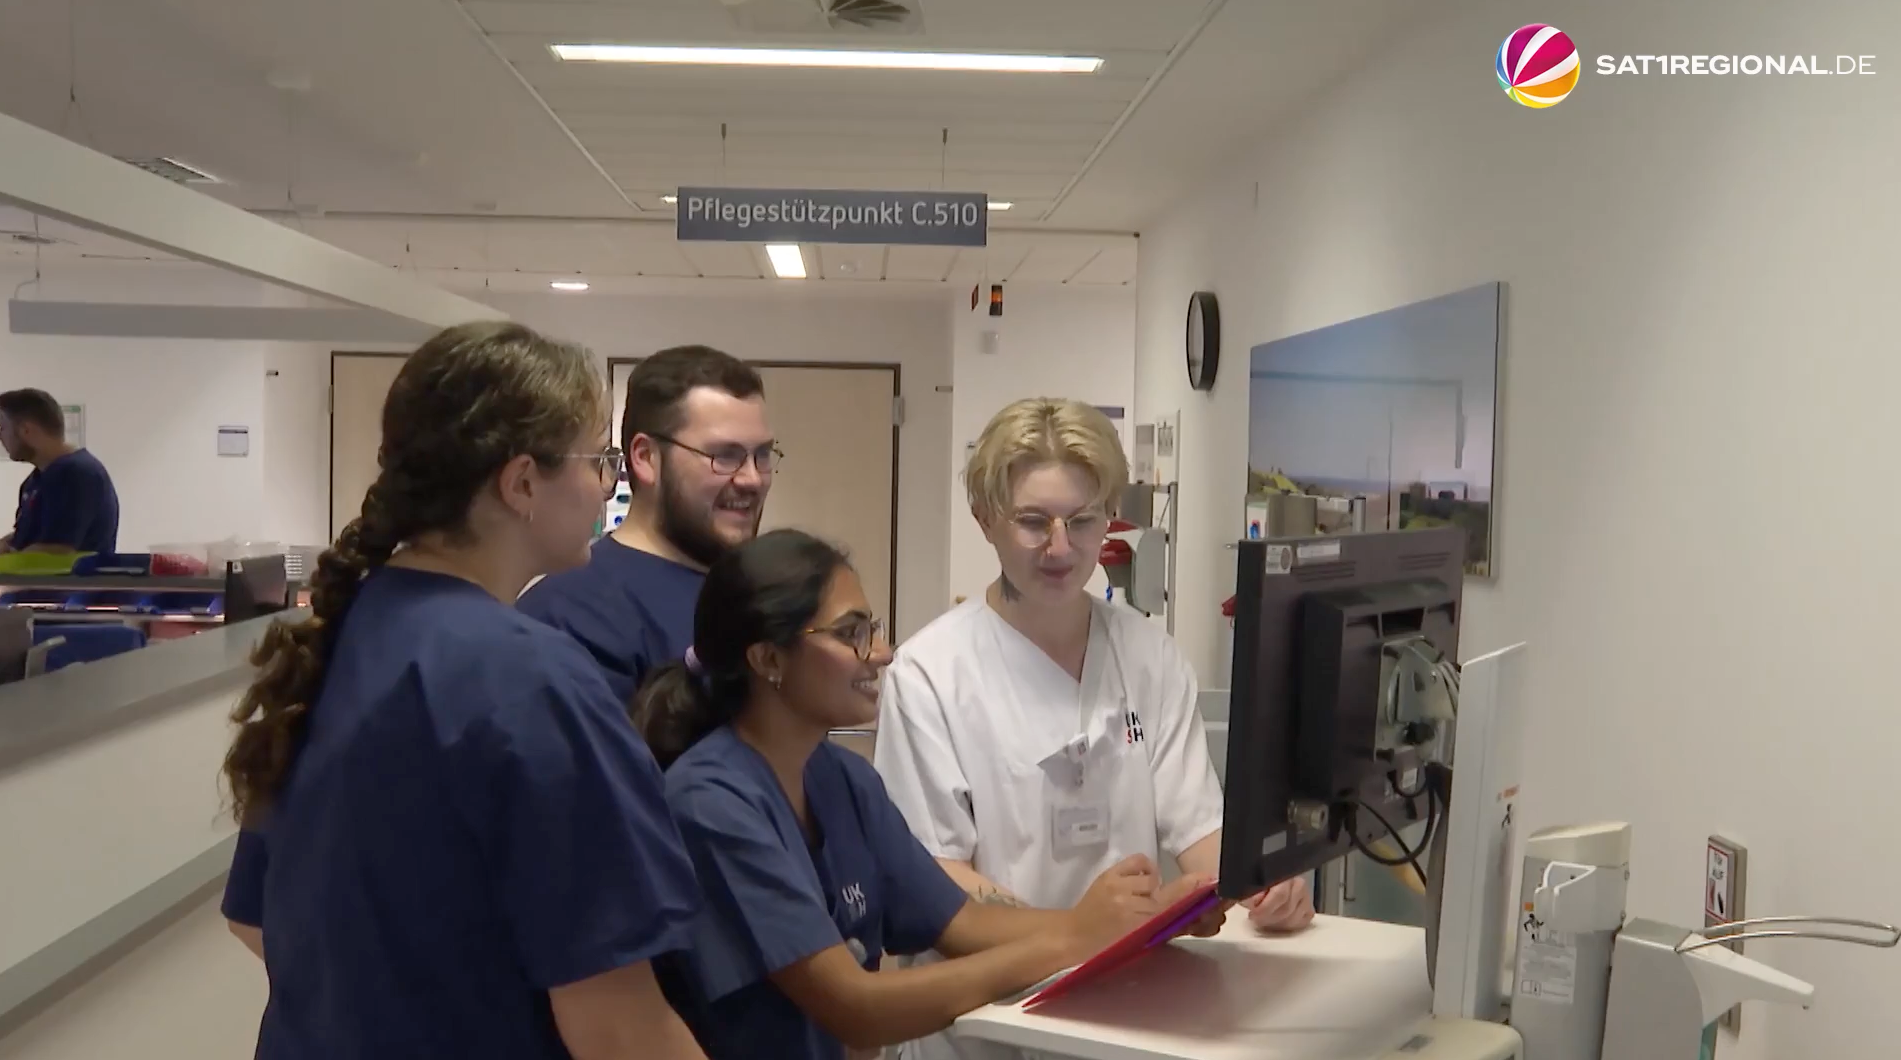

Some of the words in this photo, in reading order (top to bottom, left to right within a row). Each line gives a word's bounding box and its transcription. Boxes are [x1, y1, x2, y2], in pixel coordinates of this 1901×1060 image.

[687, 196, 903, 230] Pflegestützpunkt
[911, 201, 979, 226] C.510
[1127, 727, 1144, 744] SH
[842, 882, 865, 905] UK
